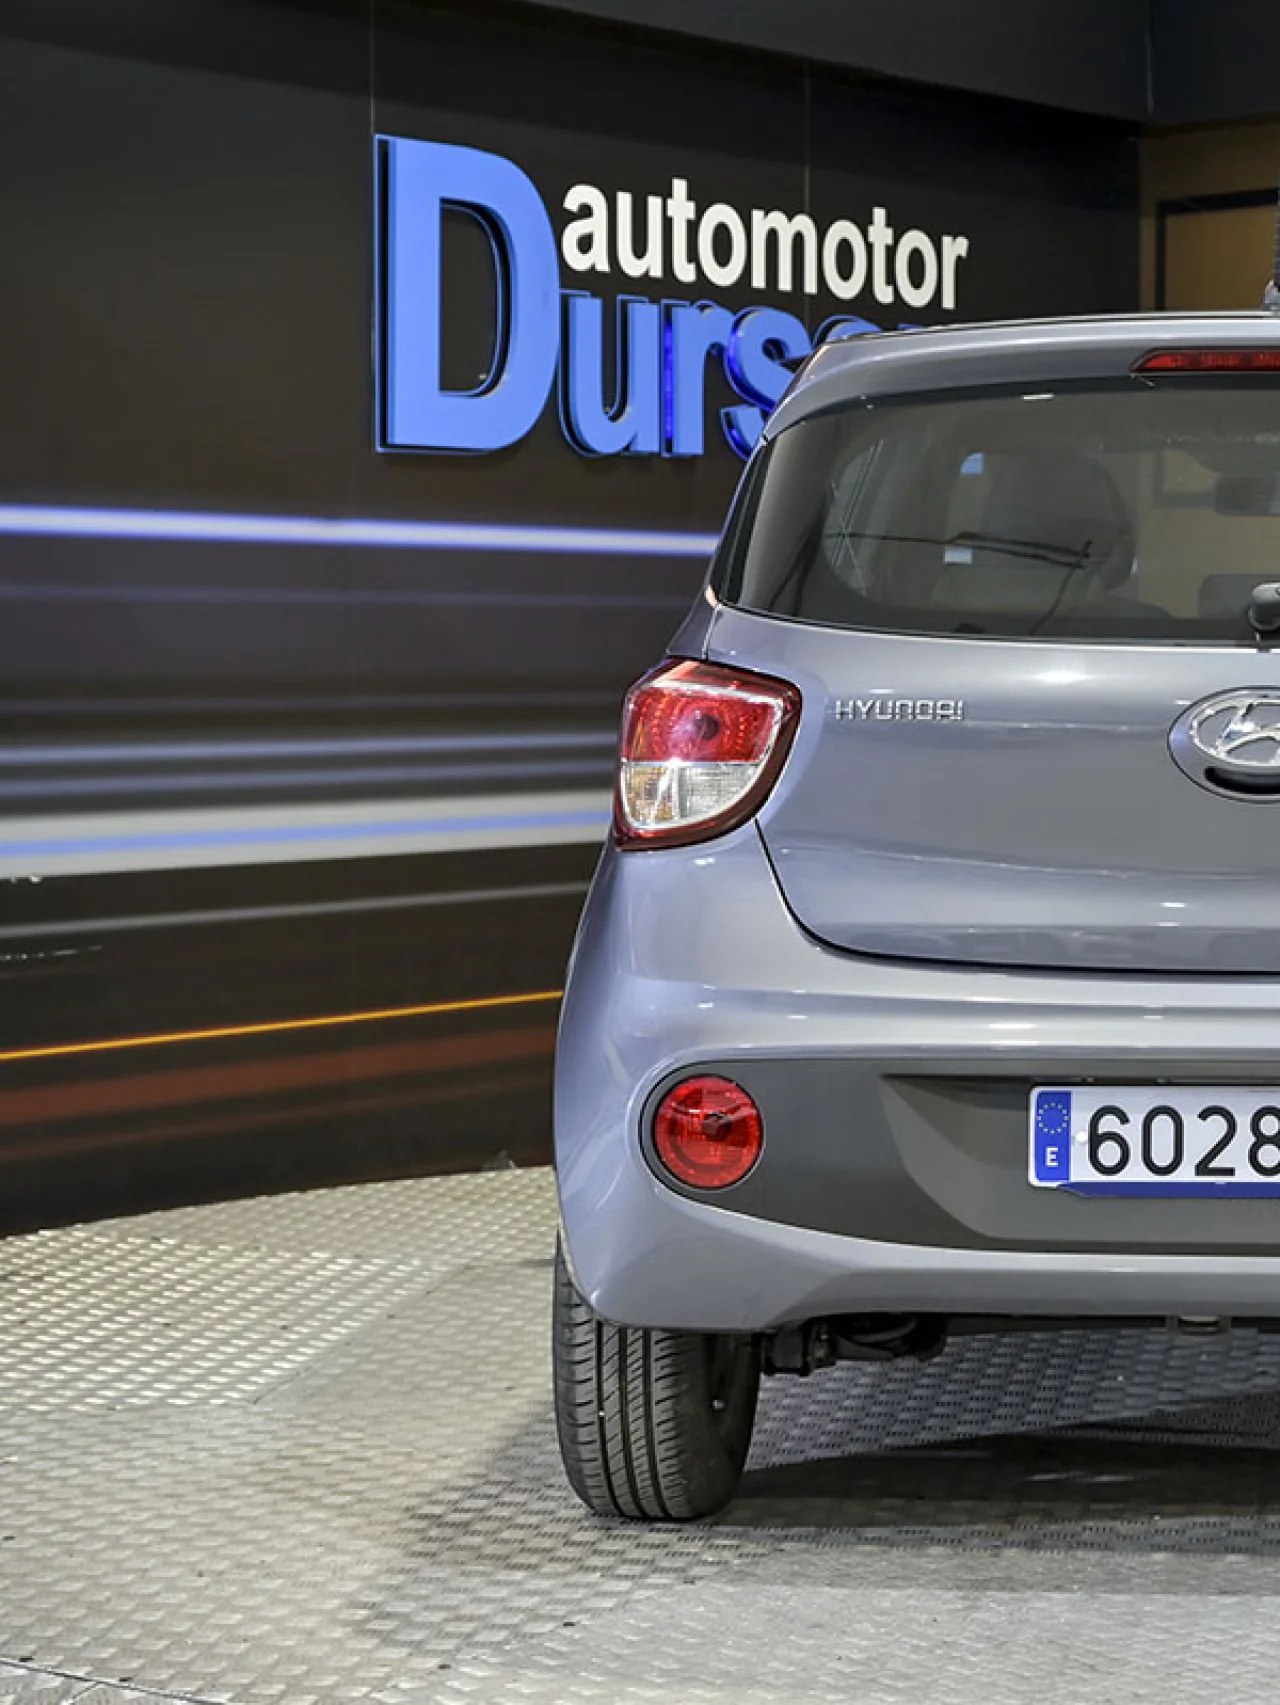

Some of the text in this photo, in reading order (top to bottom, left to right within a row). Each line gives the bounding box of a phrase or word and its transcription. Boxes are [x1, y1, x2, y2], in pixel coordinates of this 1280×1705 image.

[562, 177, 969, 310] automotor
[374, 134, 924, 462] Durs
[835, 699, 963, 720] HYUNDAI
[1045, 1146, 1059, 1167] E
